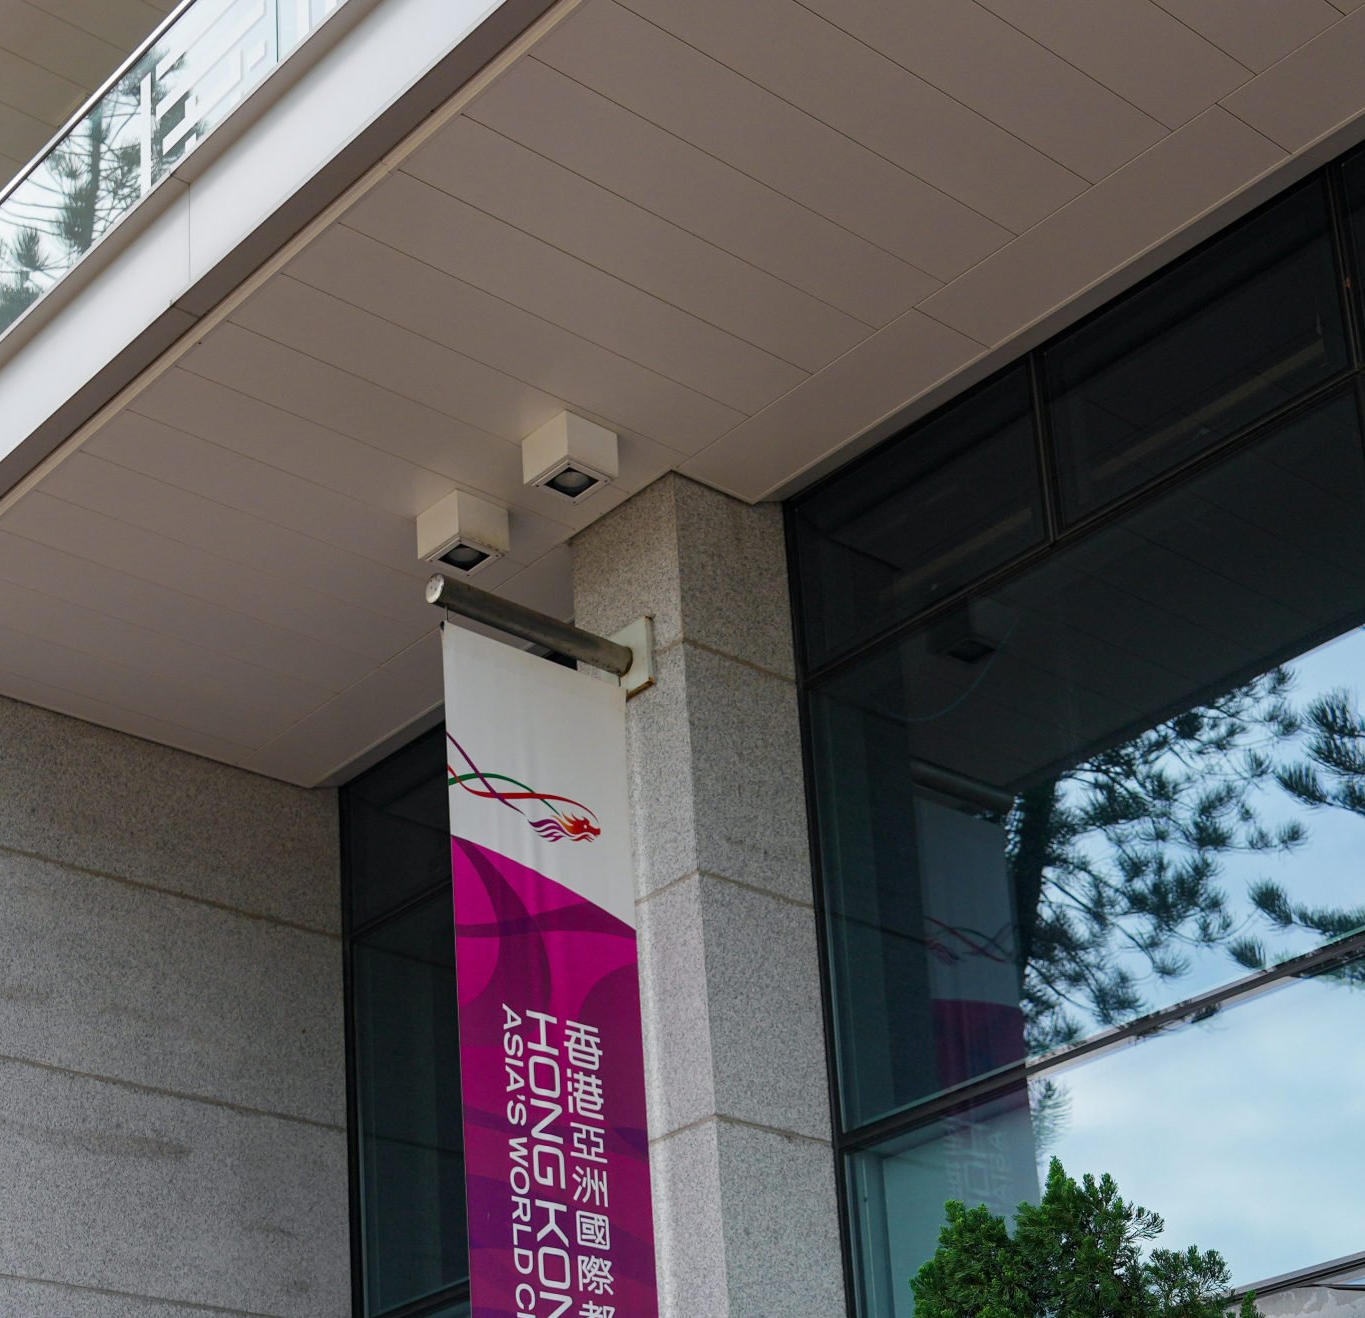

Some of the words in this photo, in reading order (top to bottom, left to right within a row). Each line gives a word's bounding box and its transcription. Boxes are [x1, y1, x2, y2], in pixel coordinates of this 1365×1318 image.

[502, 1003, 527, 1127] ASIA'S
[525, 1009, 567, 1190] HONG
[508, 1136, 534, 1275] WORLD
